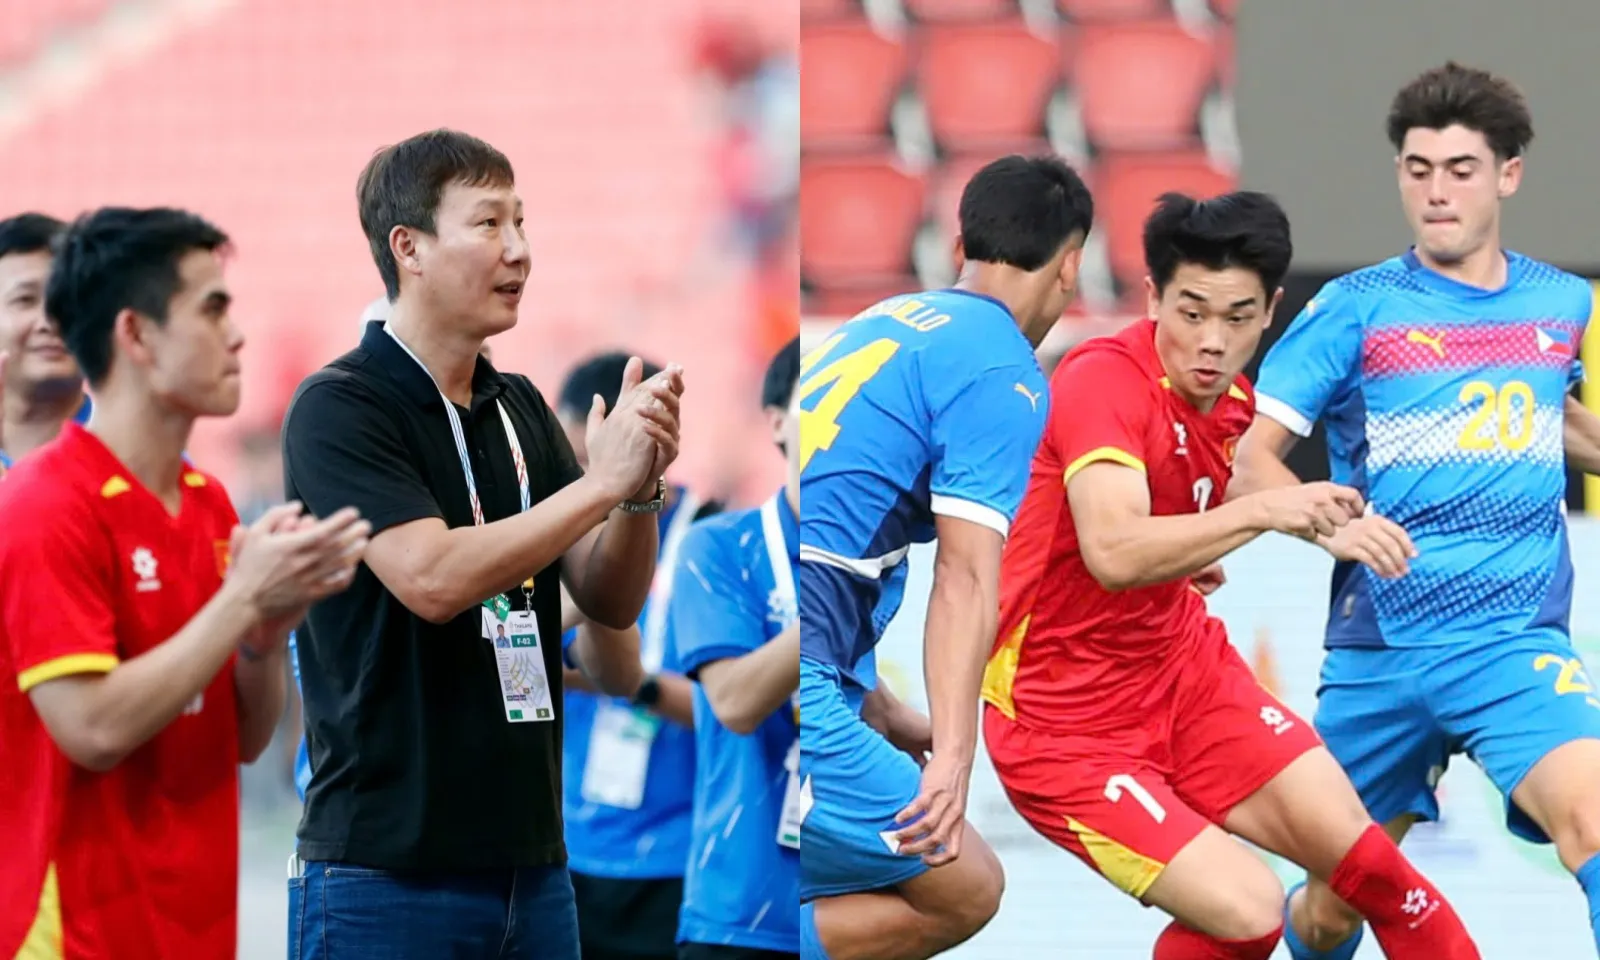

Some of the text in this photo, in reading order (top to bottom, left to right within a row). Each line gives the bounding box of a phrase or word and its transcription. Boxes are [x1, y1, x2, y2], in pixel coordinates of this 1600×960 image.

[800, 332, 901, 478] 4
[1458, 380, 1535, 451] 20
[516, 637, 532, 645] F-02
[1103, 773, 1167, 825] 7
